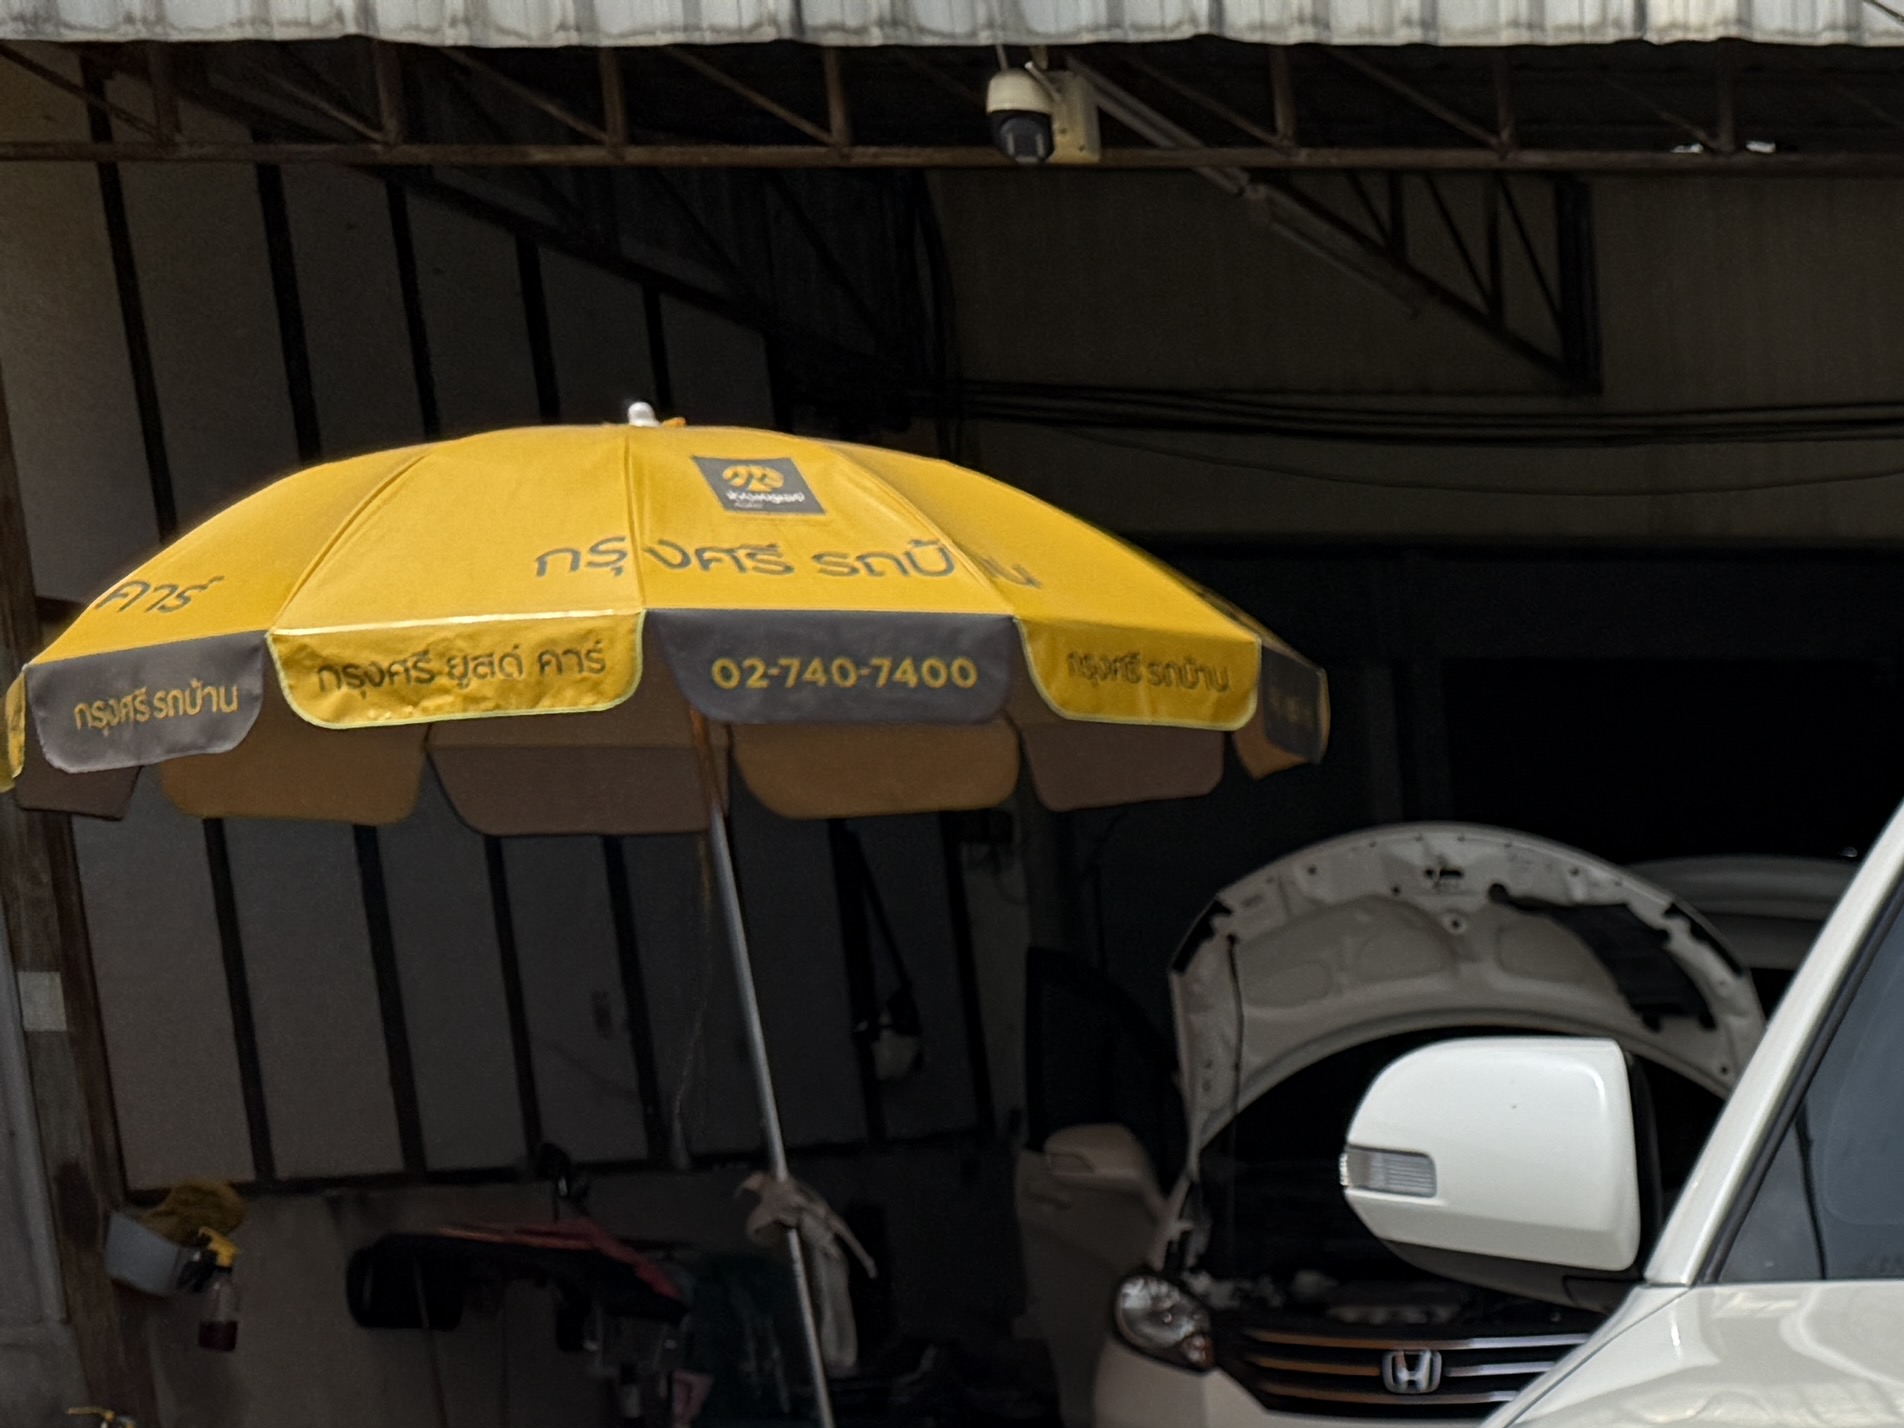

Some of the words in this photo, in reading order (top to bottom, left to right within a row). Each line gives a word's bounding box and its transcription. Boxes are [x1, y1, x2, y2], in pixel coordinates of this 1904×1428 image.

[536, 536, 795, 578] กรุงศรี
[317, 649, 437, 700] กรุงศรี
[537, 639, 606, 676] คาร์
[711, 656, 977, 689] 02-740-7400
[73, 686, 150, 737] กรุงศรี
[153, 677, 239, 720] รถบ้าน
